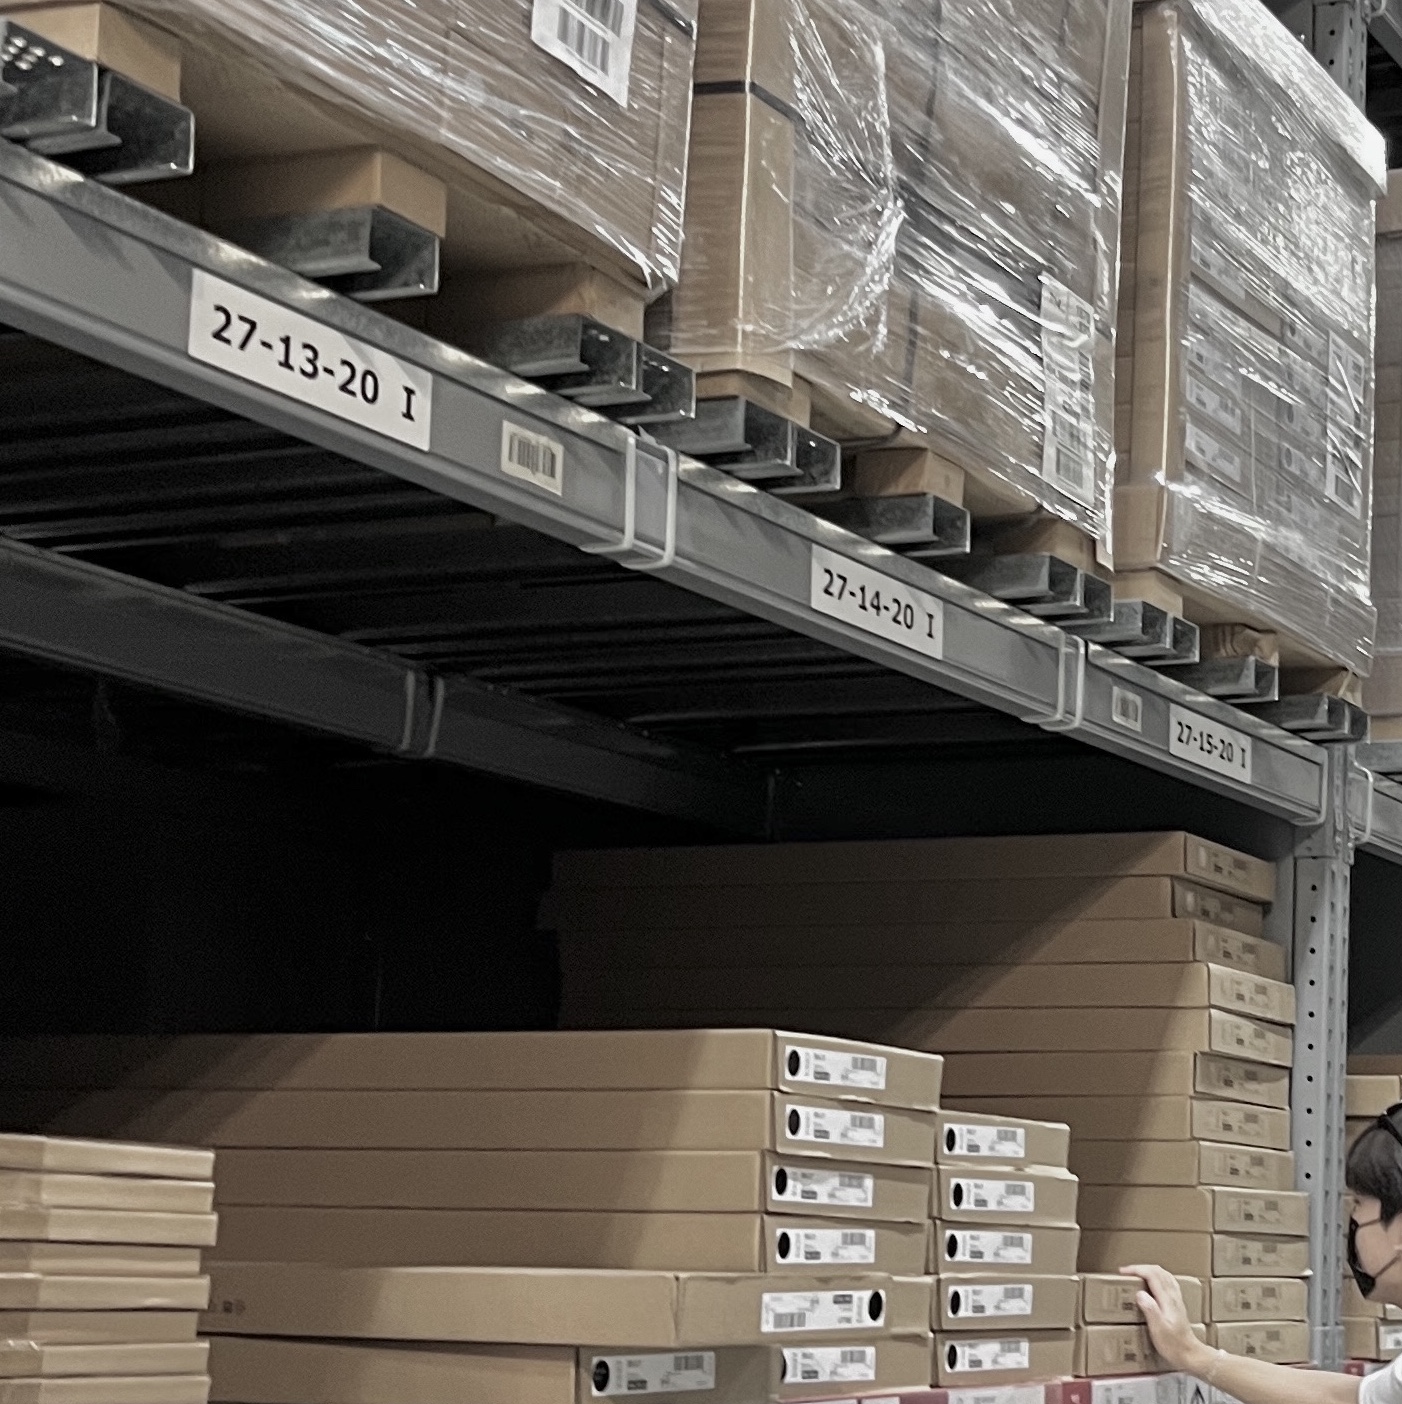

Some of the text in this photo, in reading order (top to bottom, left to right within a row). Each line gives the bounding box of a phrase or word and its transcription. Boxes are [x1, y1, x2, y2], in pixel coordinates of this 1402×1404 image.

[211, 304, 417, 422] 27-13-20 I
[823, 567, 935, 639] 27-14-20 I
[1177, 720, 1247, 769] 27-15-20 I
